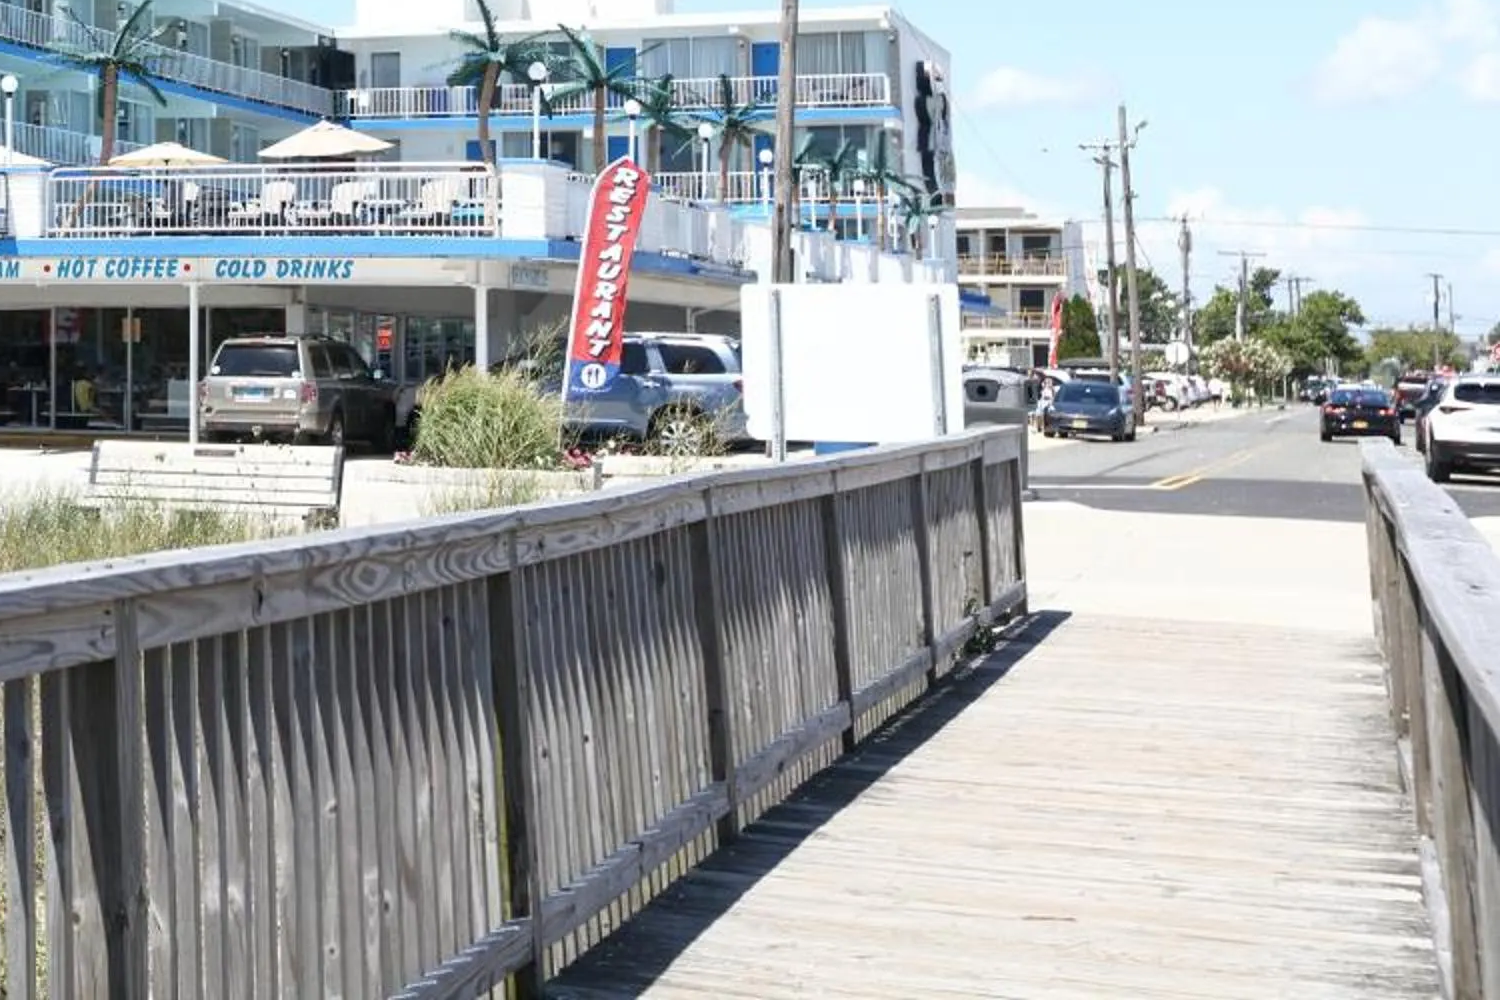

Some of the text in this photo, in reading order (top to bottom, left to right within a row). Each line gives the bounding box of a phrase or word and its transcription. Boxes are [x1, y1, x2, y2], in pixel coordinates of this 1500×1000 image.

[57, 259, 98, 278] HOT
[105, 259, 179, 278] COFFEE
[215, 259, 267, 279] COLD
[275, 259, 354, 279] DRINKS
[585, 167, 640, 357] RESTAURANT
